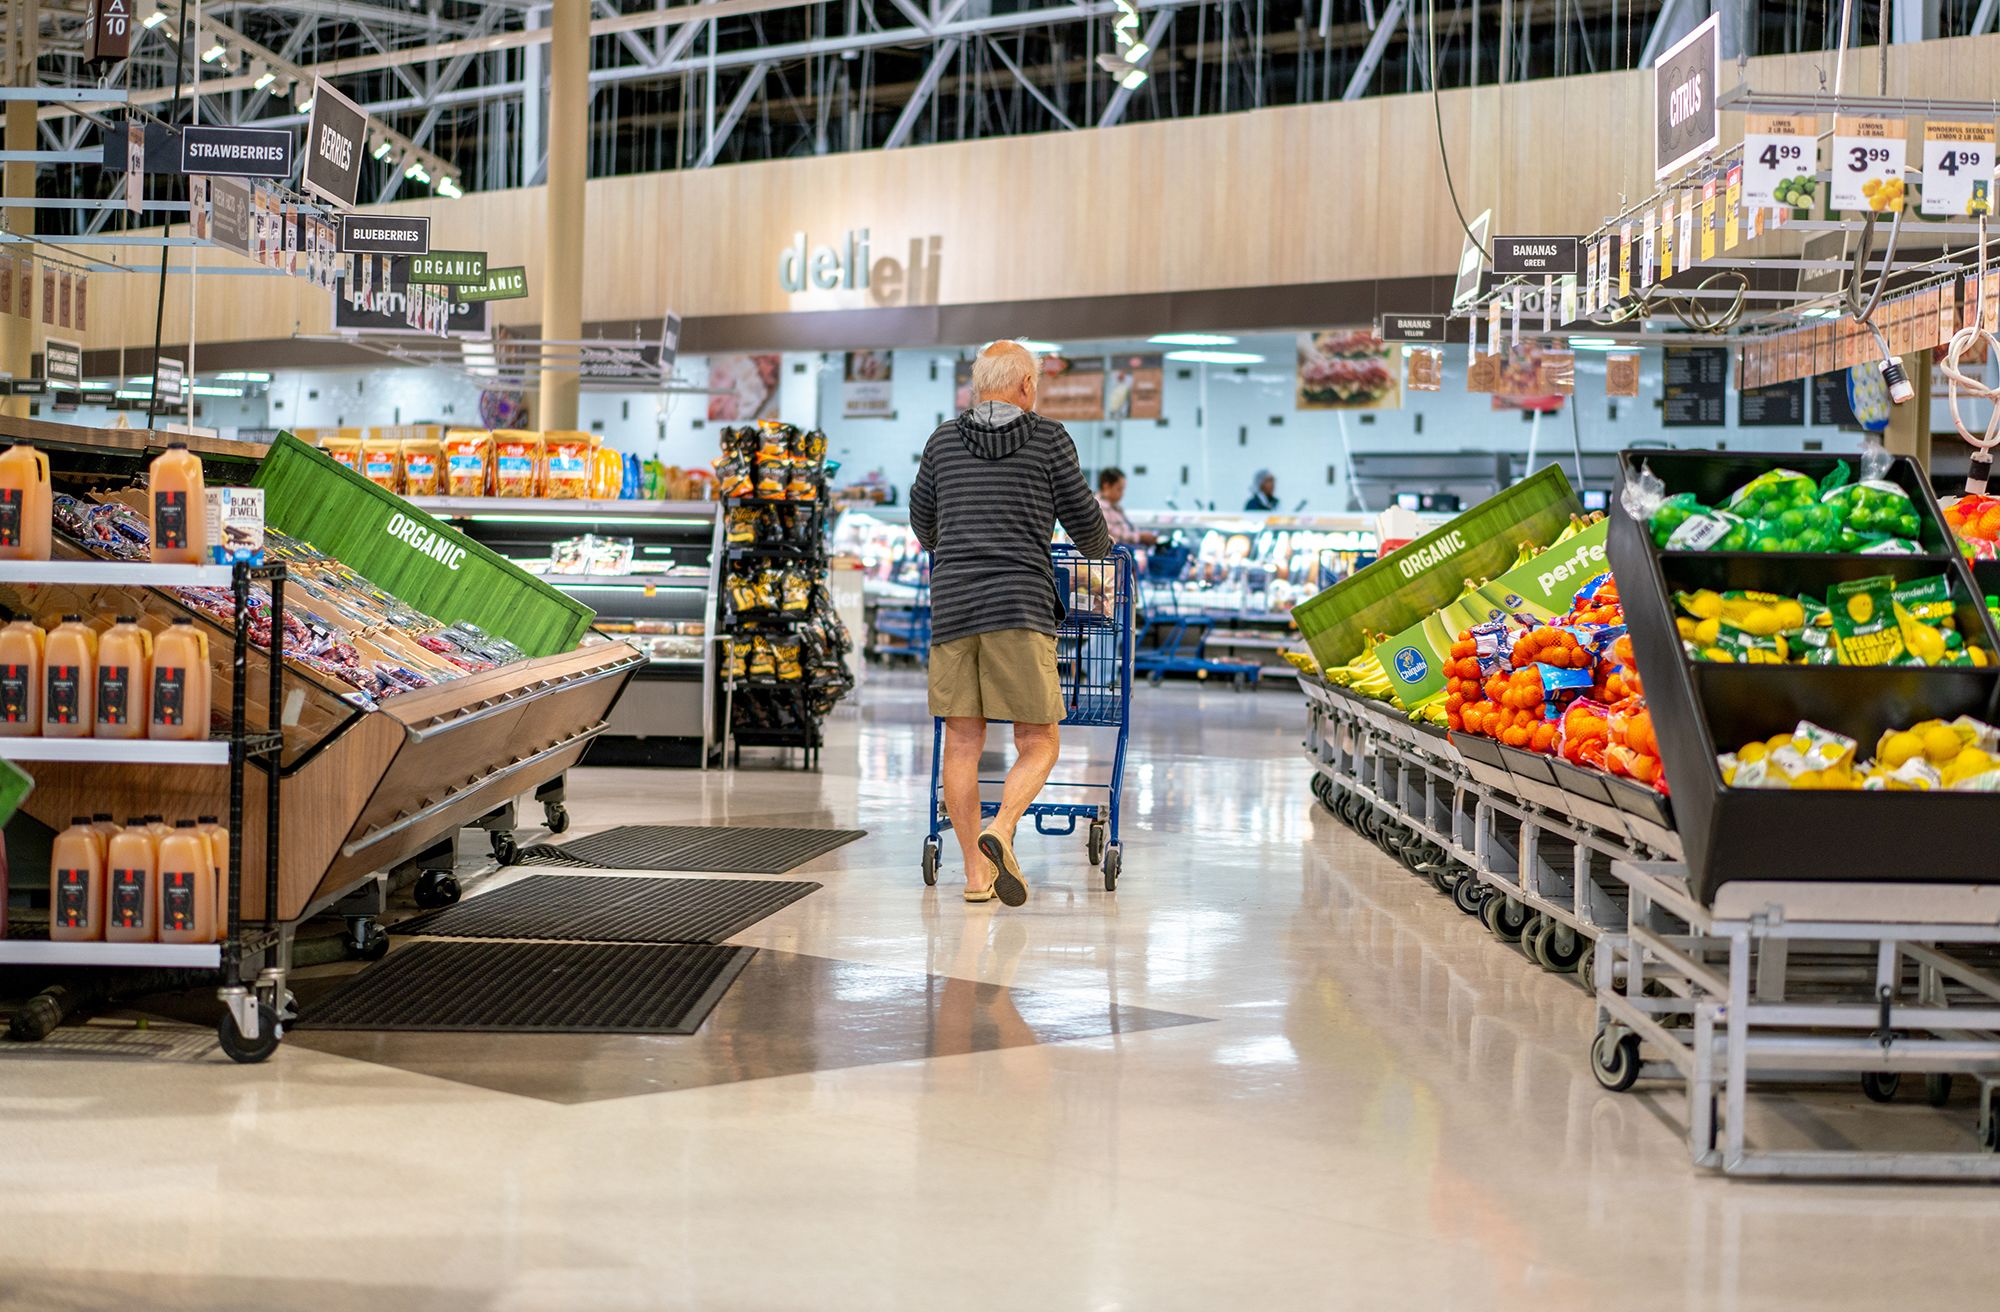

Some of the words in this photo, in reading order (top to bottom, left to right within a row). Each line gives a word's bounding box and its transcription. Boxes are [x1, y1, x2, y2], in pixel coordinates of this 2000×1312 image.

[109, 0, 124, 12] A
[107, 18, 125, 36] 10
[1670, 73, 1701, 128] CITRUS
[1772, 120, 1791, 128] LIMES
[1858, 123, 1884, 131] LEMONS
[1927, 126, 1964, 134] WONDERFUL
[1966, 126, 1996, 134] SEEDLESS
[189, 143, 284, 161] STRAWBERRIES
[320, 123, 353, 172] BERRIES
[353, 228, 418, 242] BLUEBERRIES
[1513, 245, 1557, 256] BANANAS
[413, 259, 481, 276] ORGANIC
[779, 228, 870, 293] deli
[1524, 258, 1546, 267] GREEN
[1398, 319, 1431, 328] BANANAS
[231, 497, 257, 507] BLACK
[229, 507, 258, 517] JEWELL
[386, 513, 466, 571] ORGANIC
[1399, 530, 1466, 579] ORGANIC
[1400, 661, 1428, 680] Chiquita
